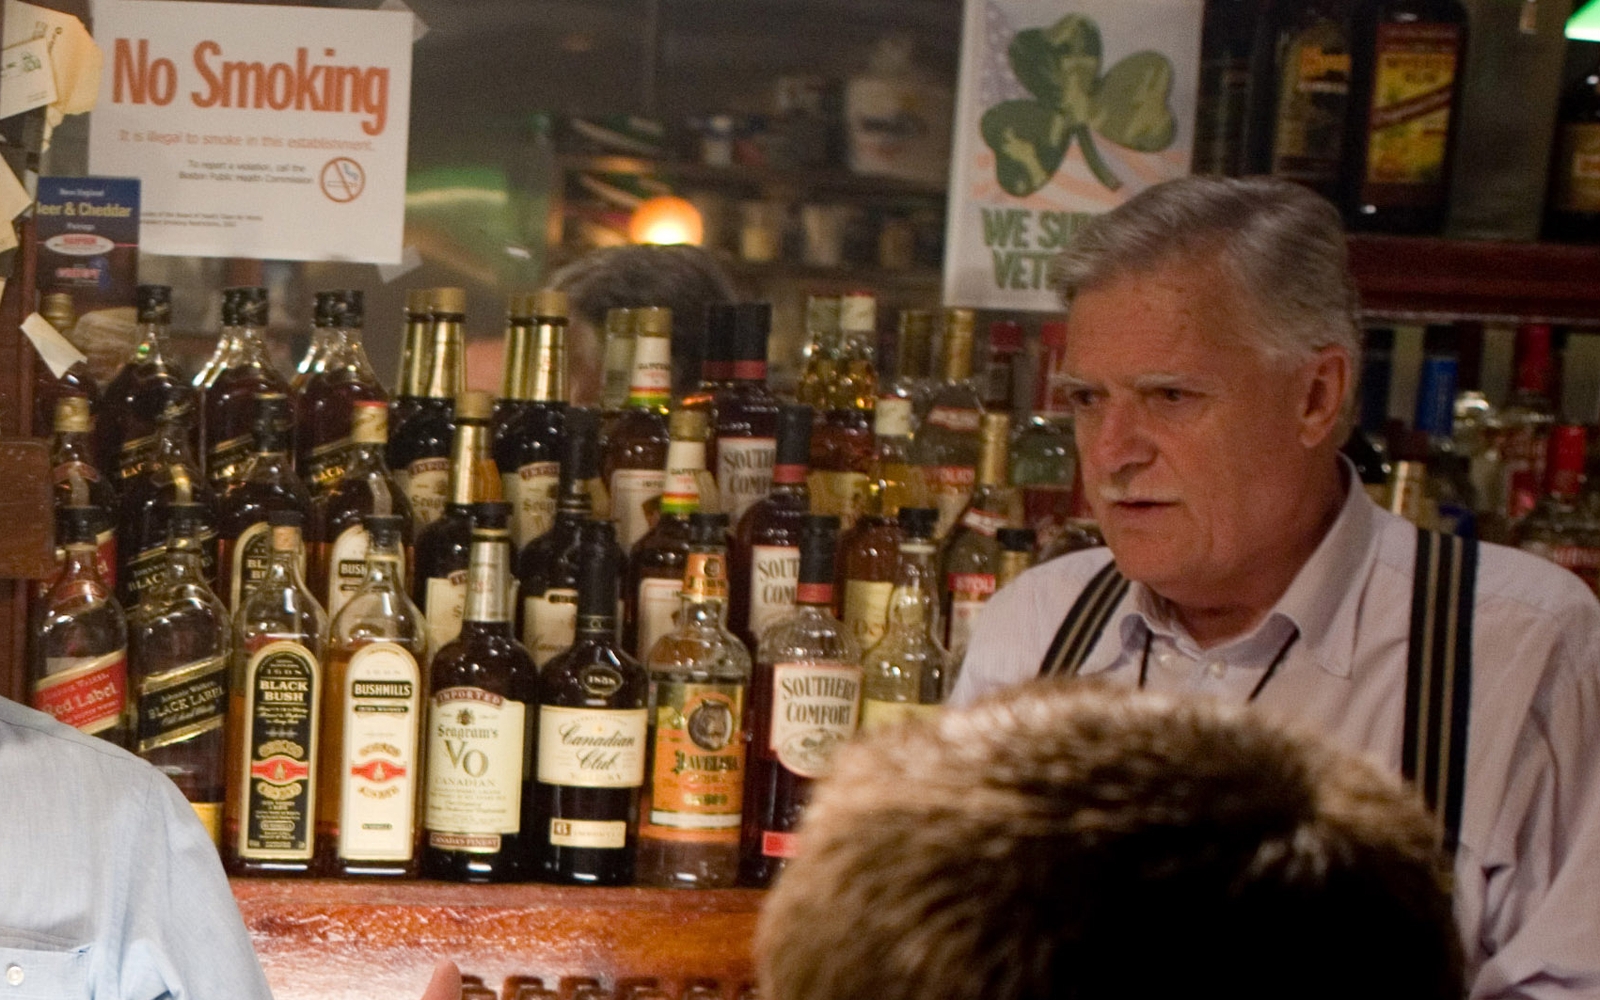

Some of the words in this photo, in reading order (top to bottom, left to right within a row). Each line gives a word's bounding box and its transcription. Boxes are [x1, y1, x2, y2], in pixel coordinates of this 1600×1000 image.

[112, 37, 178, 106] No
[190, 40, 390, 136] Smoking
[146, 130, 182, 146] illegal
[186, 131, 199, 144] to
[202, 131, 243, 146] smoke
[261, 134, 284, 148] this
[64, 201, 76, 216] &
[78, 202, 133, 217] Cheddar
[981, 208, 1031, 248] WE
[76, 682, 118, 708] Label
[260, 680, 308, 691] BLACK
[355, 683, 411, 697] BUSHMILLS
[148, 697, 189, 719] BLACK
[191, 685, 225, 706] LABEL
[264, 691, 304, 702] BUSH
[439, 689, 501, 705] IMPORTED
[438, 724, 499, 740] Seagram's
[558, 722, 636, 747] Canadian
[444, 739, 489, 778] VO
[576, 748, 621, 771] Club
